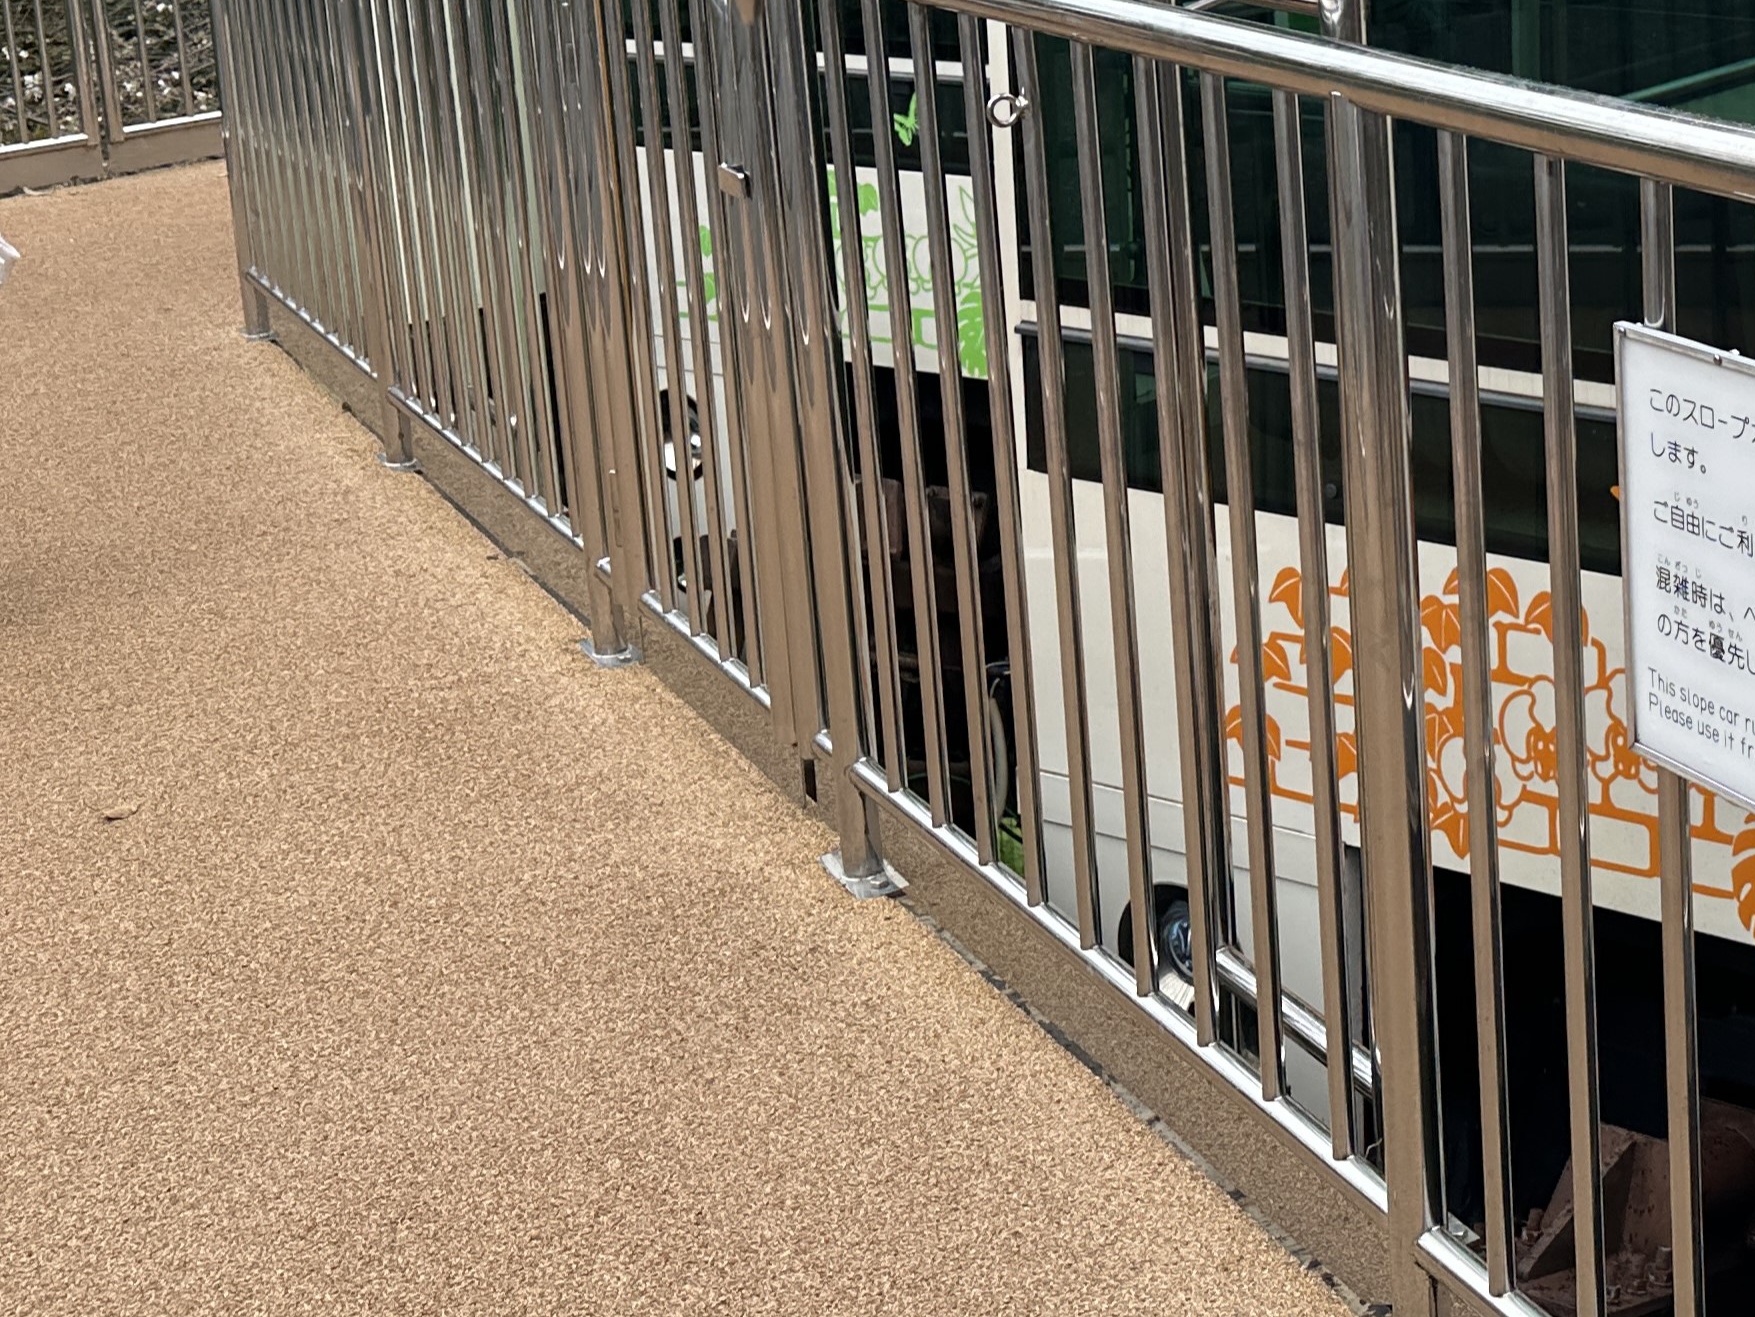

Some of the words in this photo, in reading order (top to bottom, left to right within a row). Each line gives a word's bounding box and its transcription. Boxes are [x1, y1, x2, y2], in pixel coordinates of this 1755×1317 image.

[1651, 432, 1706, 474] します。
[1648, 667, 1675, 697] This
[1680, 687, 1714, 715] slope
[1719, 706, 1739, 726] car
[1649, 692, 1693, 730] Please
[1698, 720, 1719, 743] use
[1725, 733, 1734, 750] it
